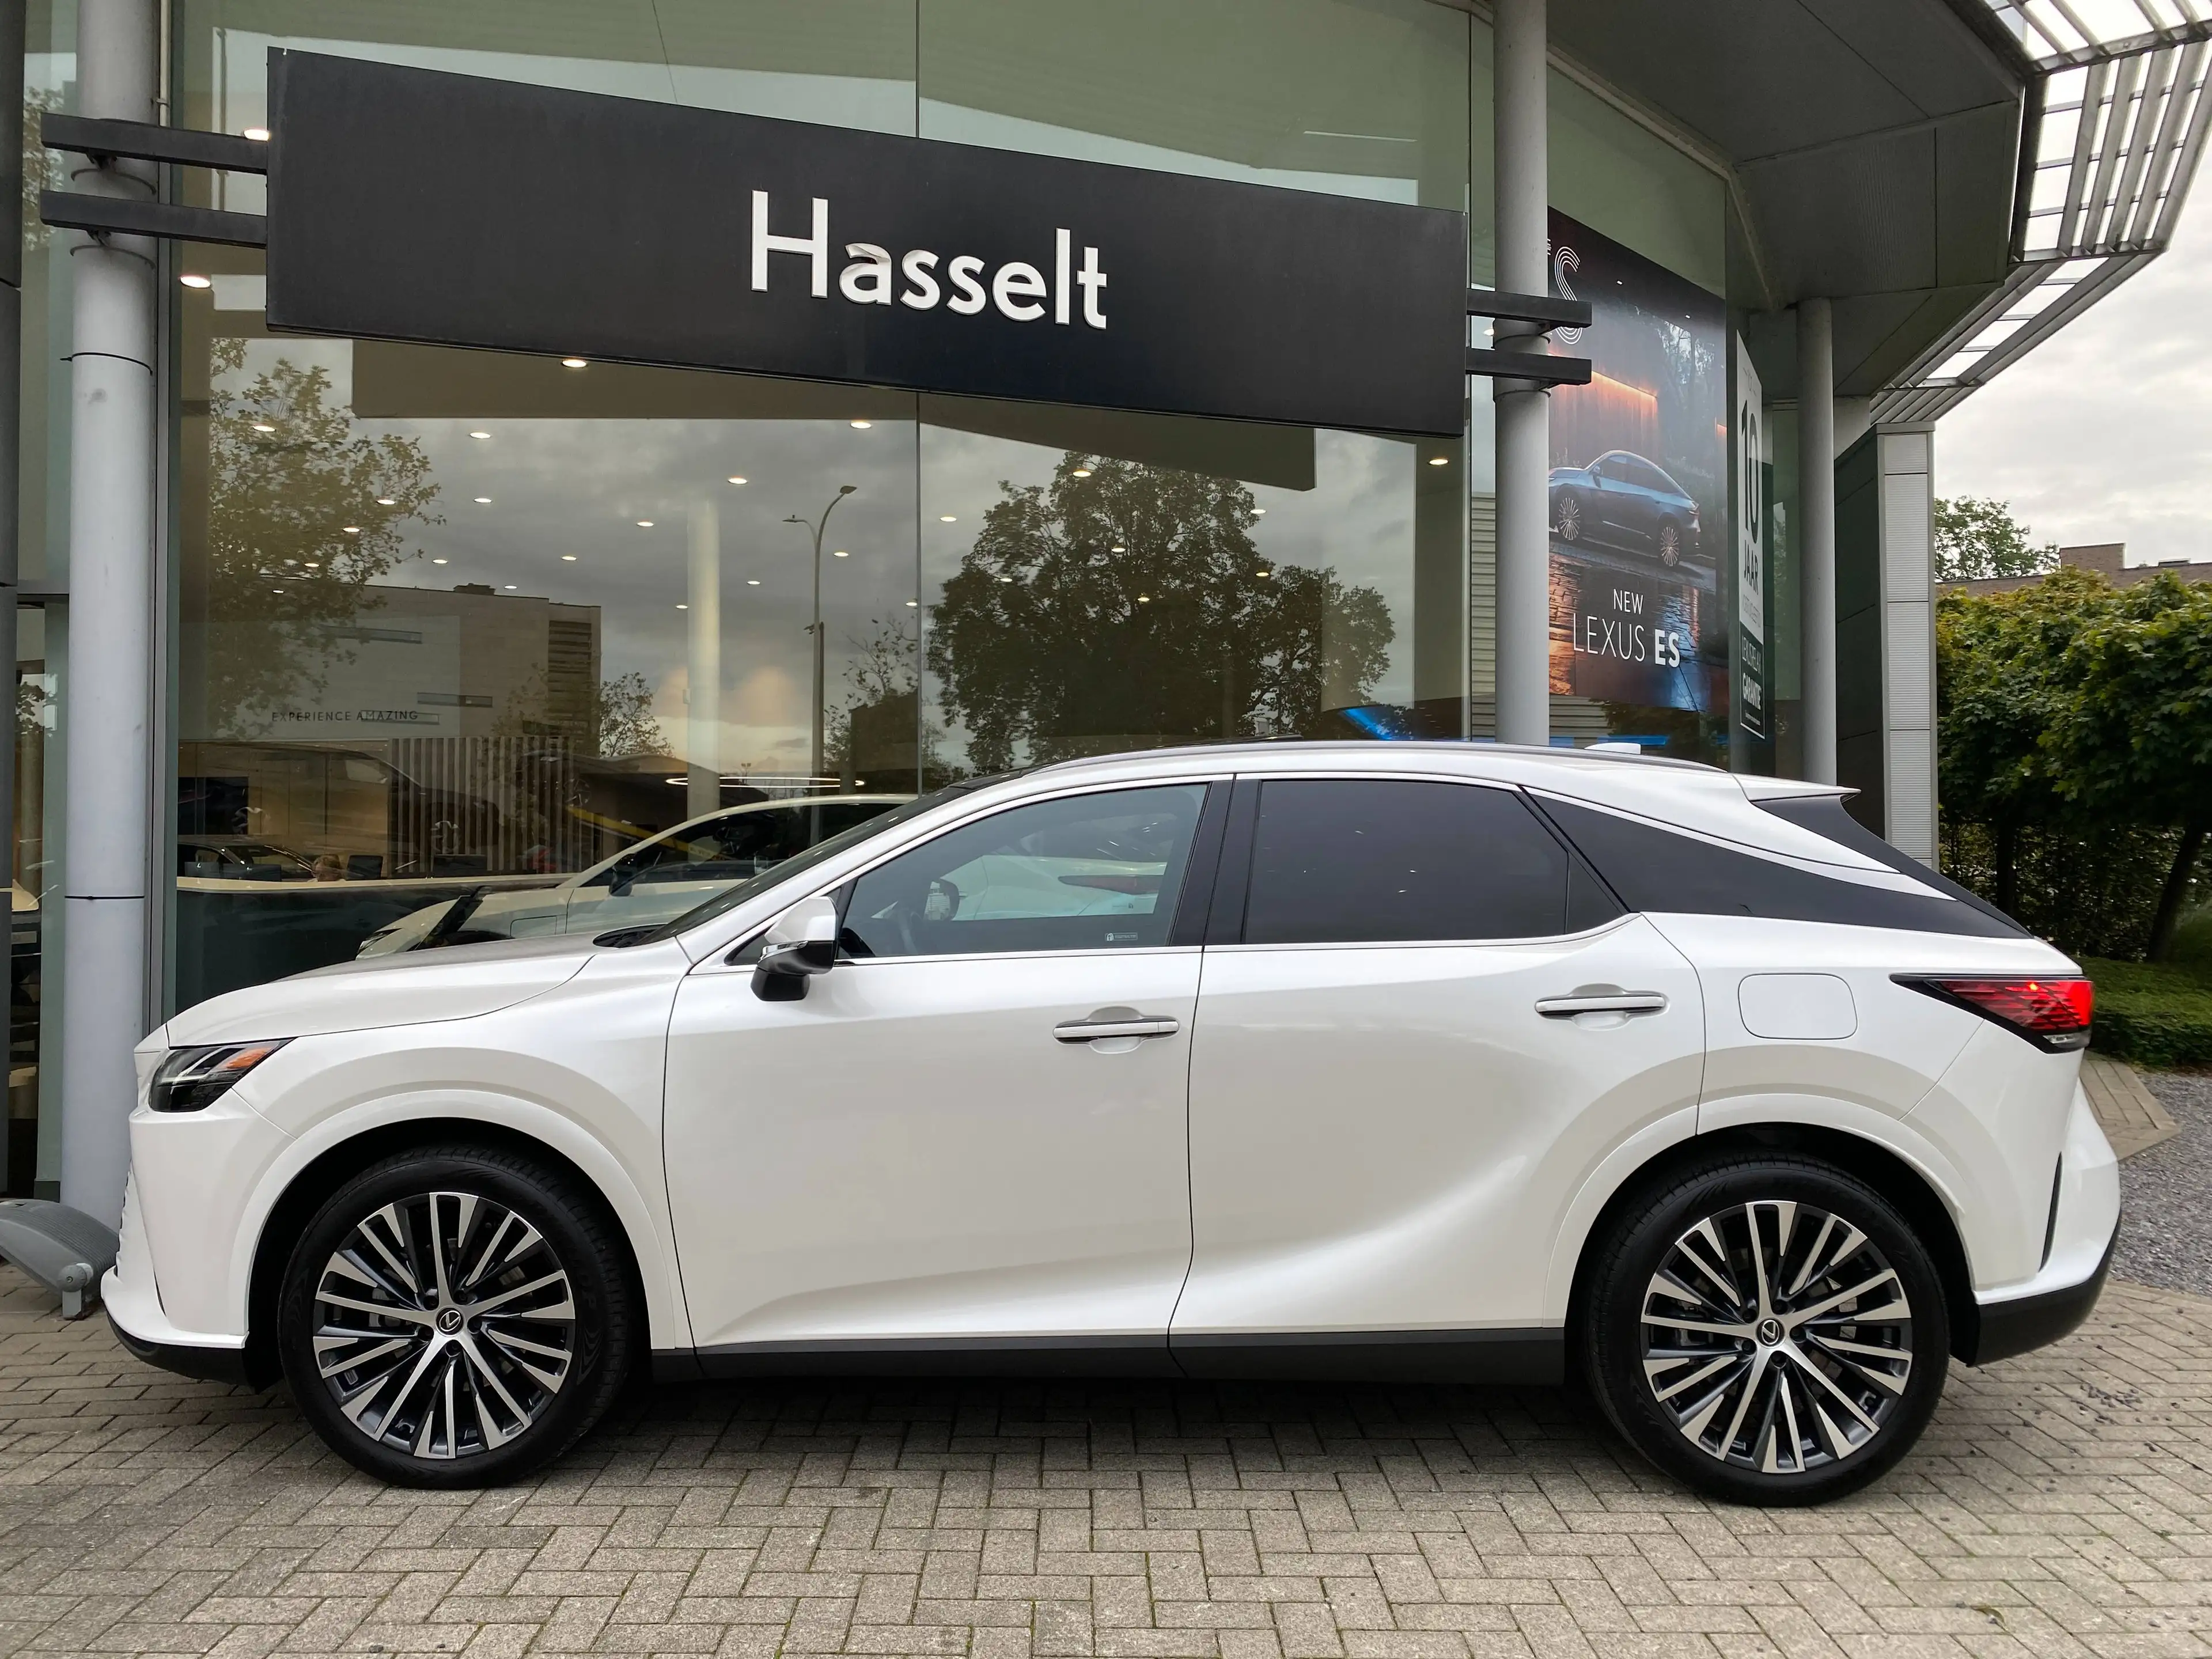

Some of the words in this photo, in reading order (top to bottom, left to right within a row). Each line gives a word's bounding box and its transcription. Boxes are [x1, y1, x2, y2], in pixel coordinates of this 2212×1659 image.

[751, 190, 1107, 330] Hasselt
[1741, 400, 1759, 544] 10
[1744, 539, 1759, 596] JAAR
[1613, 588, 1643, 615] NEW
[1573, 612, 1646, 662] LEXUS
[1654, 628, 1680, 668] ES
[271, 711, 351, 721] EXPERIENCE
[356, 710, 418, 720] AMAZING
